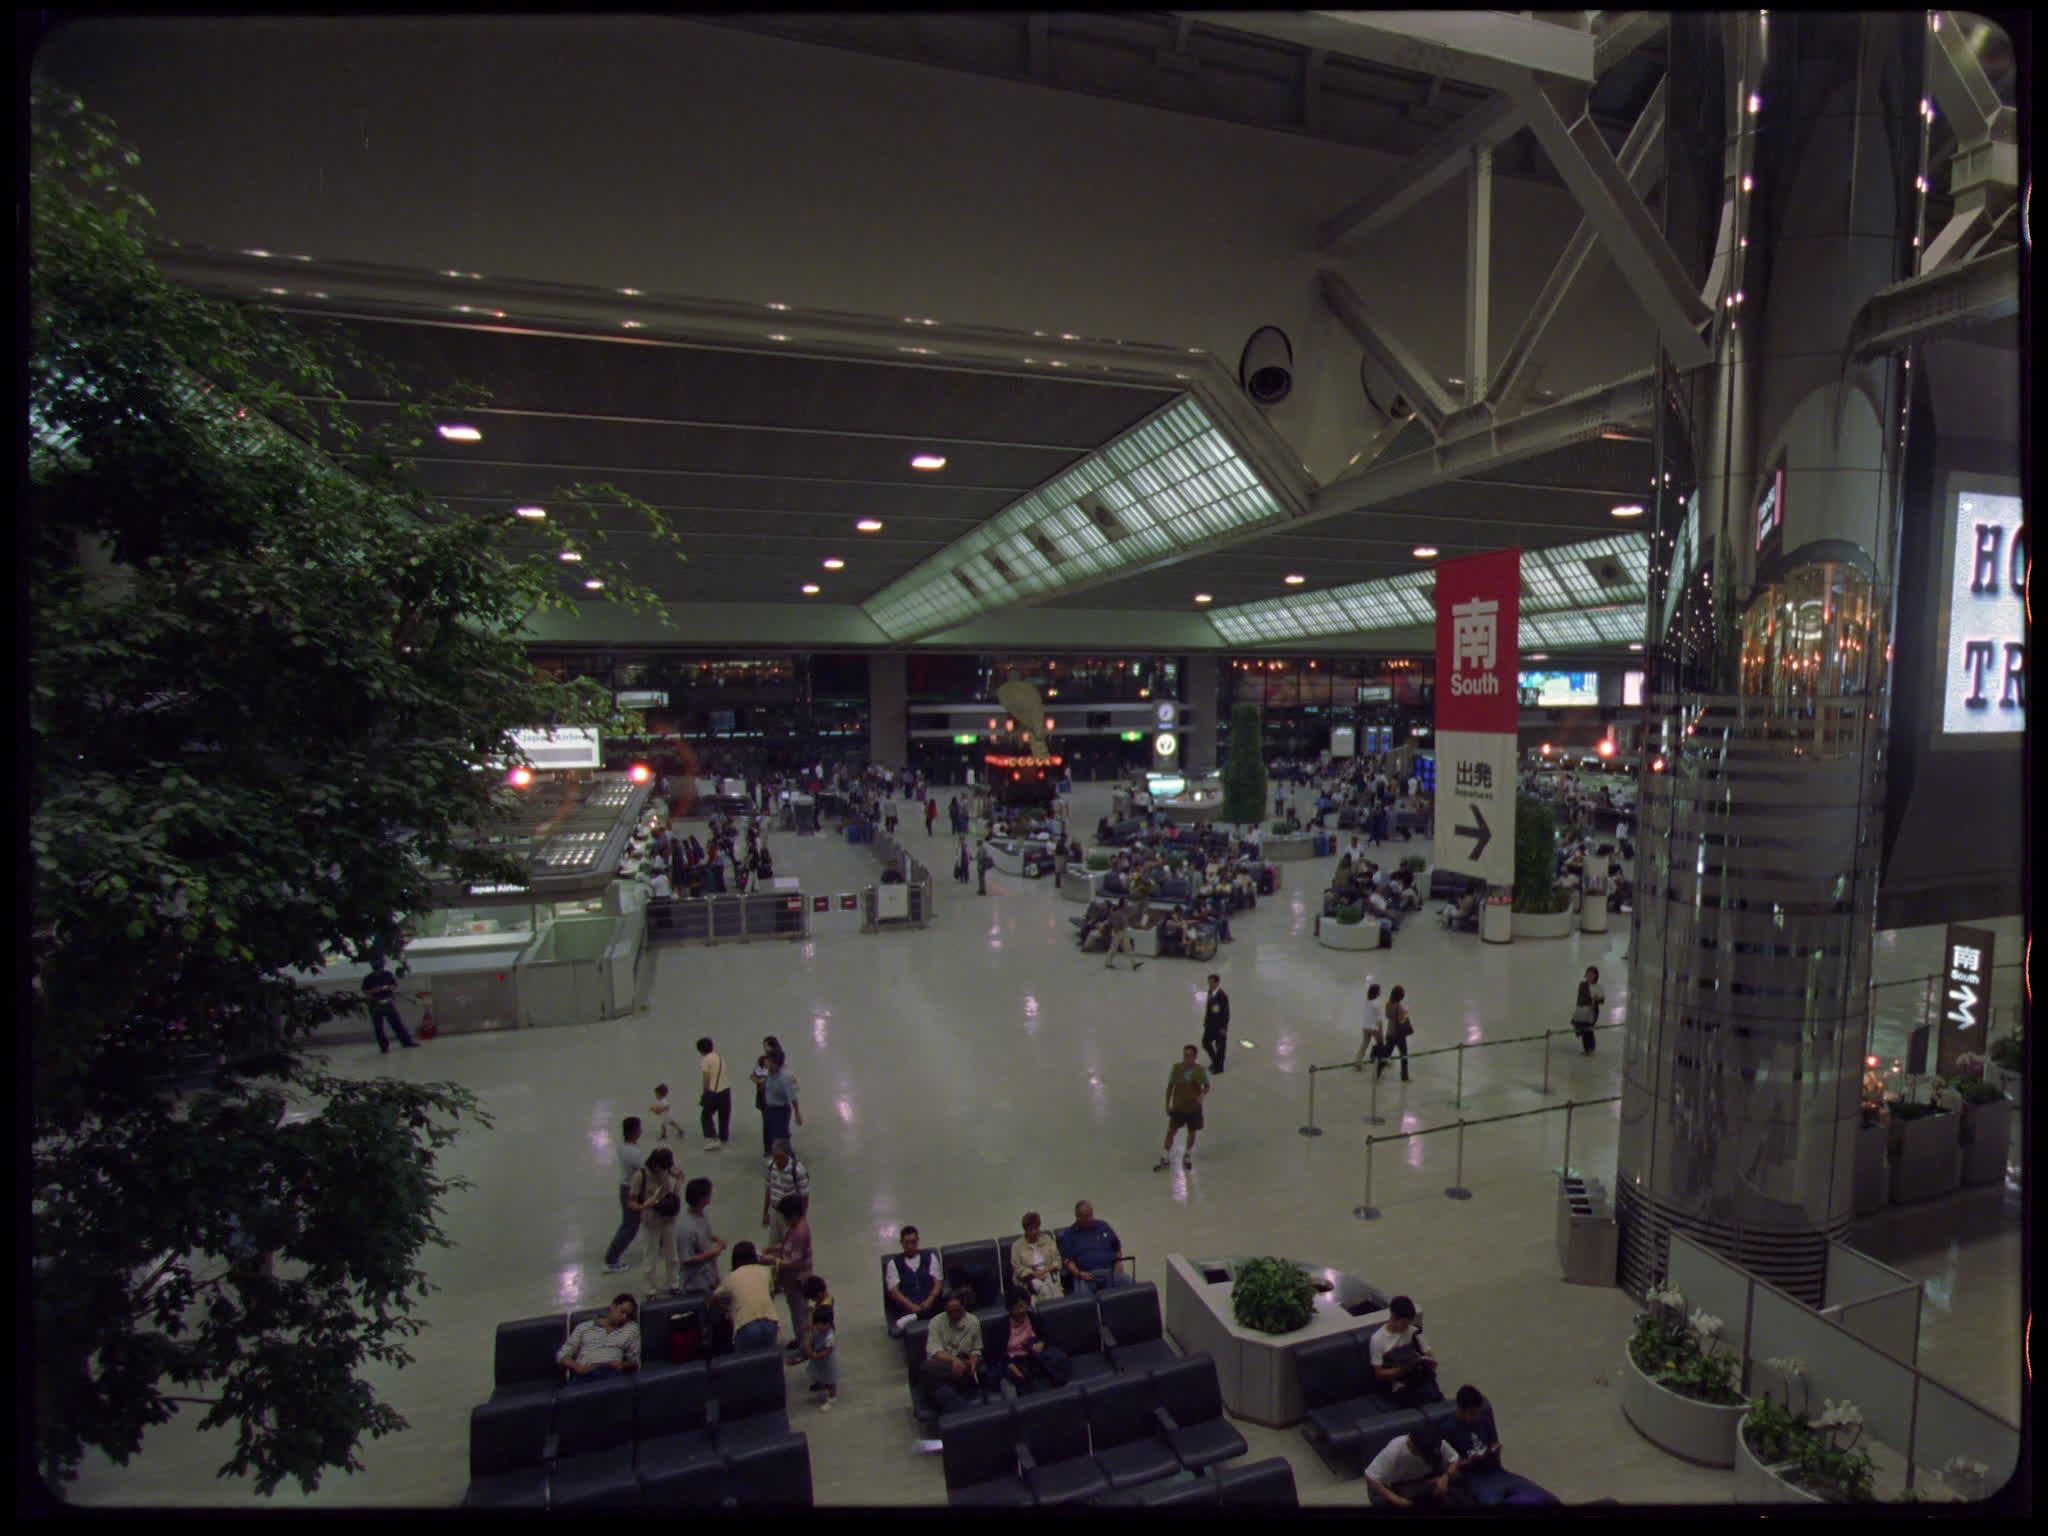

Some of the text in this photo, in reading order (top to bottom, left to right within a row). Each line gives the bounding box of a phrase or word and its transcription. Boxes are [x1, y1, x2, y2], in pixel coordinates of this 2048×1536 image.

[1451, 597, 1499, 670] 南
[1451, 672, 1499, 696] South
[1456, 760, 1492, 789] 出発
[1953, 944, 1981, 971] 南
[1950, 969, 1980, 984] South
